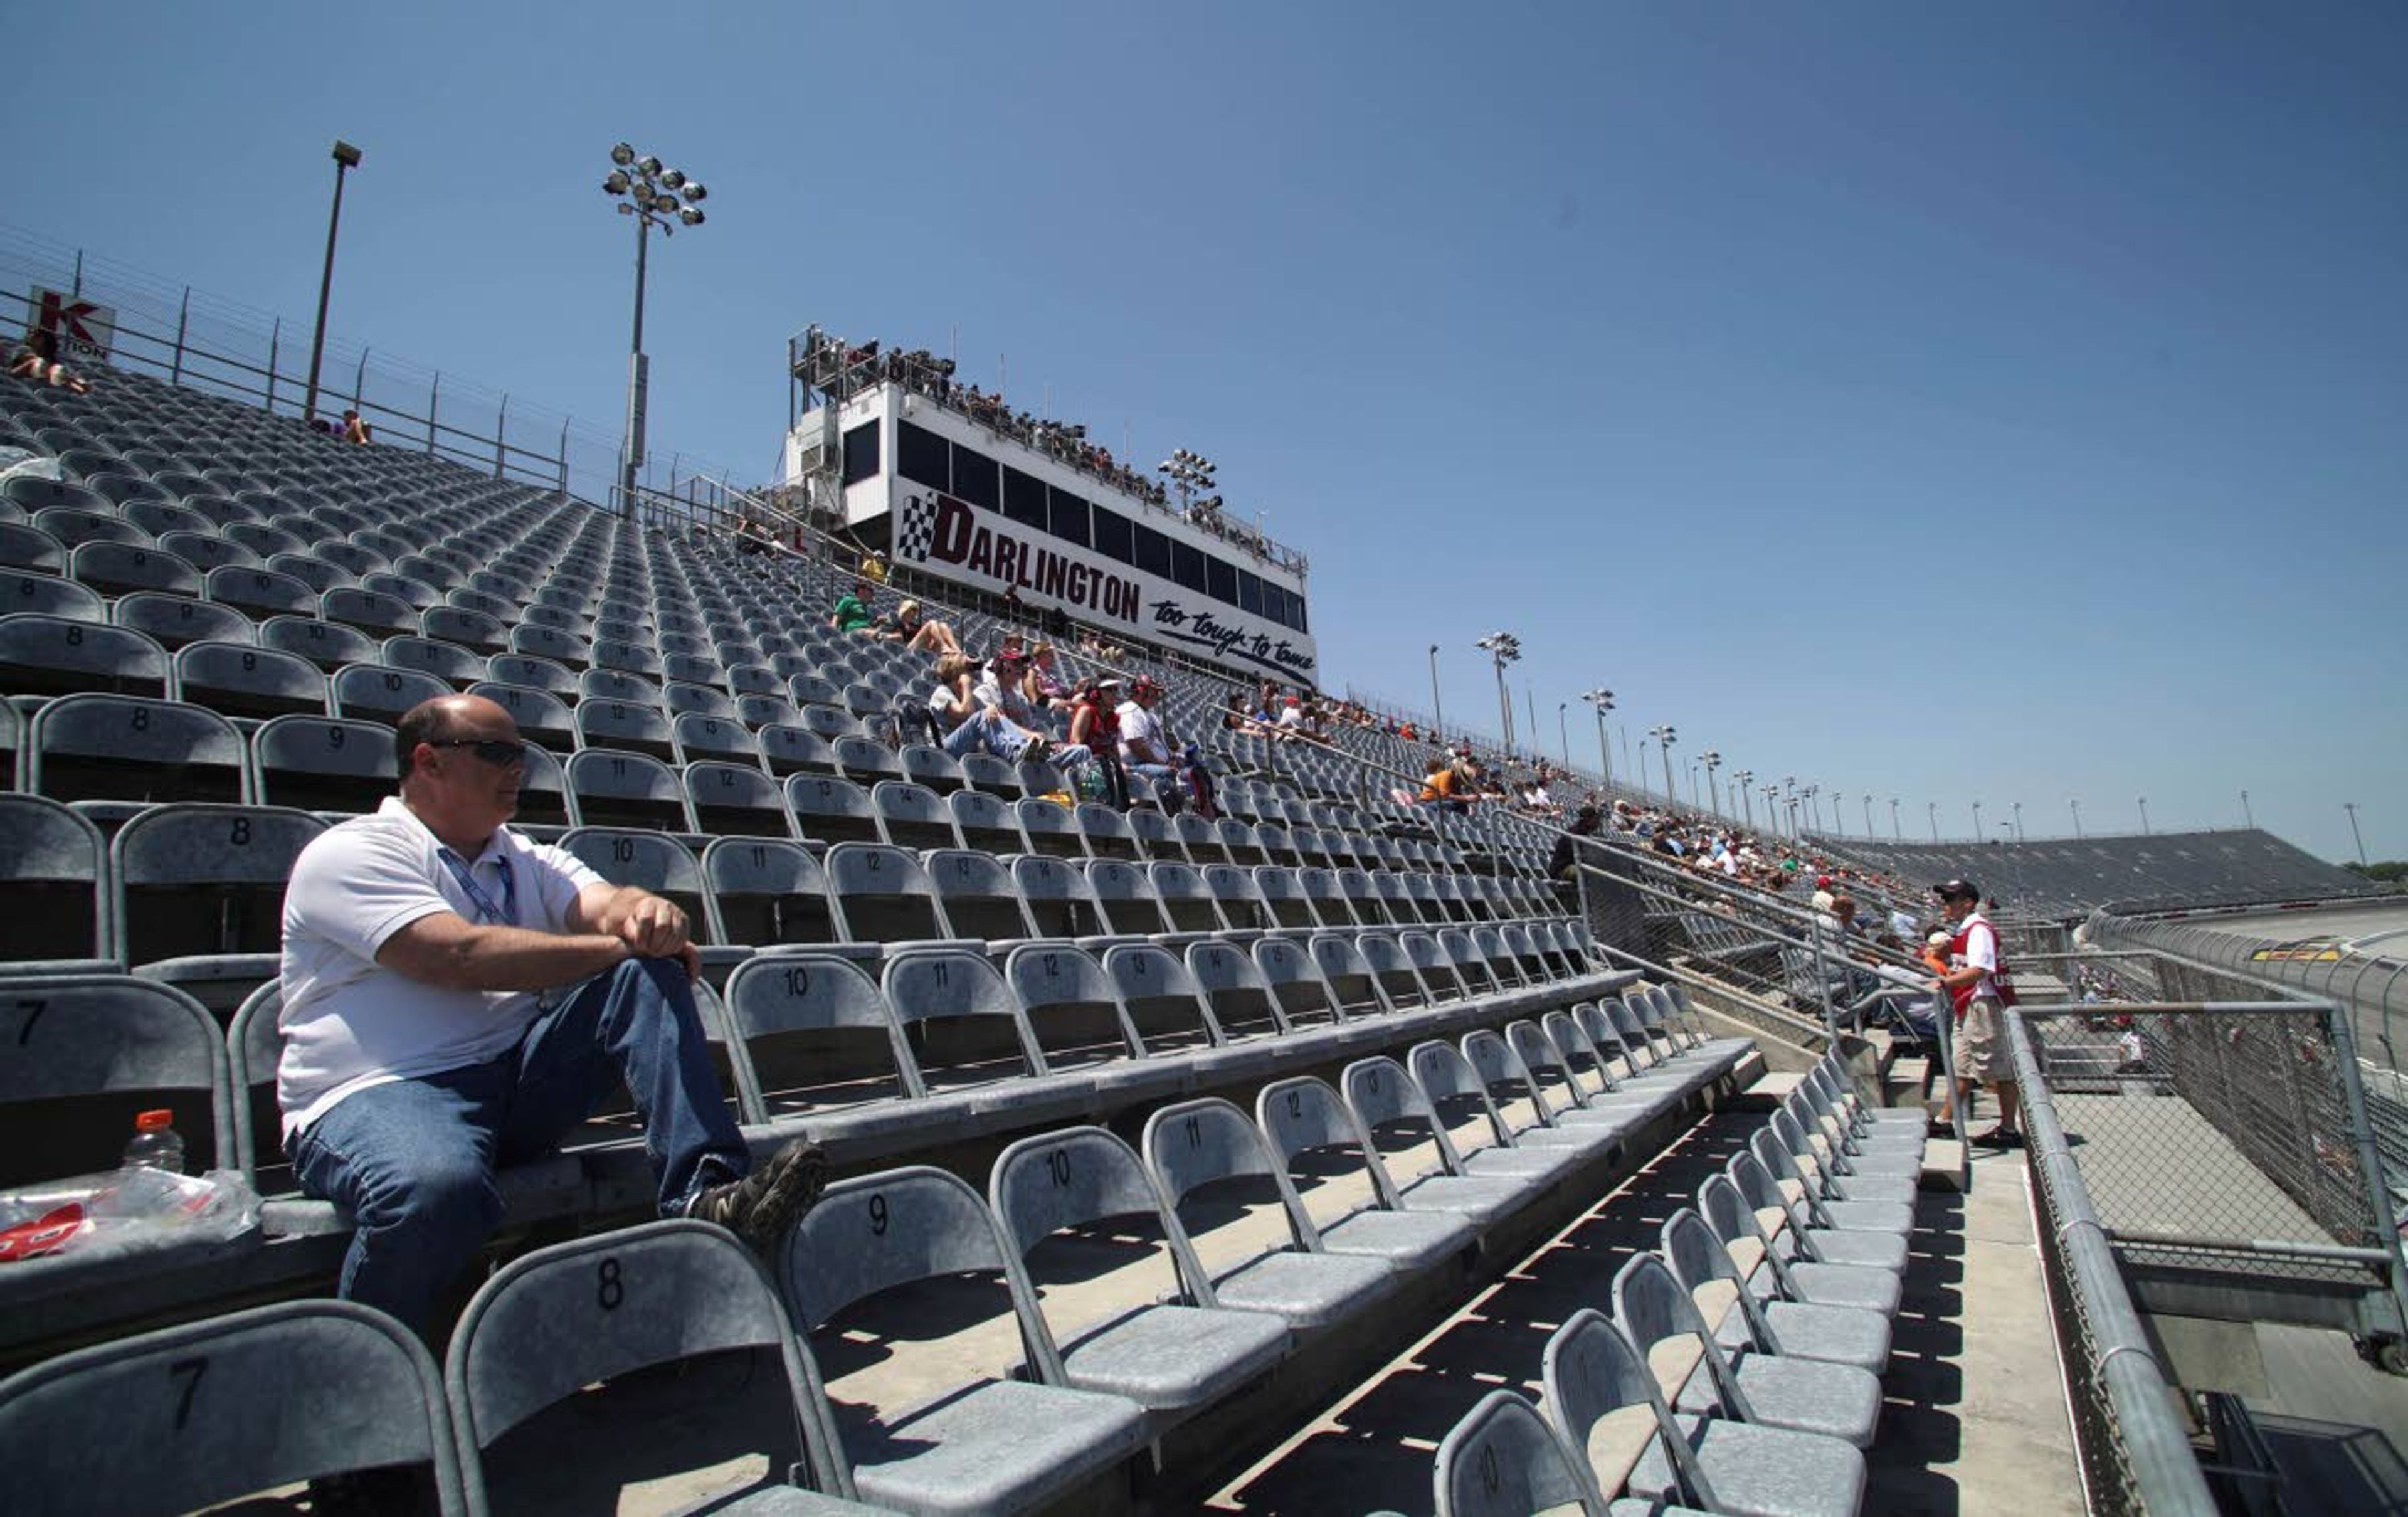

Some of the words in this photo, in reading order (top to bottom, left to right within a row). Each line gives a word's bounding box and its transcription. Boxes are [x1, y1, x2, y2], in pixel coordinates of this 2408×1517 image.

[39, 291, 99, 342] K
[929, 493, 1140, 623] DARLINGTON
[21, 578, 34, 595] 8
[256, 576, 270, 589] 10
[66, 626, 82, 645] 8
[310, 626, 324, 638] 10
[1149, 600, 1190, 626] too
[1192, 612, 1247, 656] tough
[1249, 633, 1271, 657] to
[243, 653, 256, 670] 9
[426, 646, 436, 658] 11
[385, 674, 401, 690] 10
[509, 692, 520, 707] 11
[131, 708, 149, 731] 8
[611, 704, 625, 719] 12
[329, 727, 344, 746] 9
[707, 722, 717, 734] 13
[612, 761, 625, 778] 11
[721, 771, 734, 786] 12
[818, 782, 831, 796] 13
[230, 817, 250, 845] 8
[612, 840, 634, 862] 10
[752, 847, 766, 868] 11
[867, 853, 879, 871] 12
[958, 857, 969, 875] 13
[933, 962, 948, 986] 11
[1044, 955, 1058, 976] 12
[1133, 955, 1146, 974] 13
[784, 967, 807, 995] 10
[16, 1001, 48, 1044] 7
[1288, 1092, 1301, 1119] 12
[1185, 1117, 1201, 1149] 11
[1047, 1149, 1070, 1187] 10
[869, 1195, 887, 1235] 9
[598, 1258, 623, 1311] 8
[172, 1358, 209, 1429] 7
